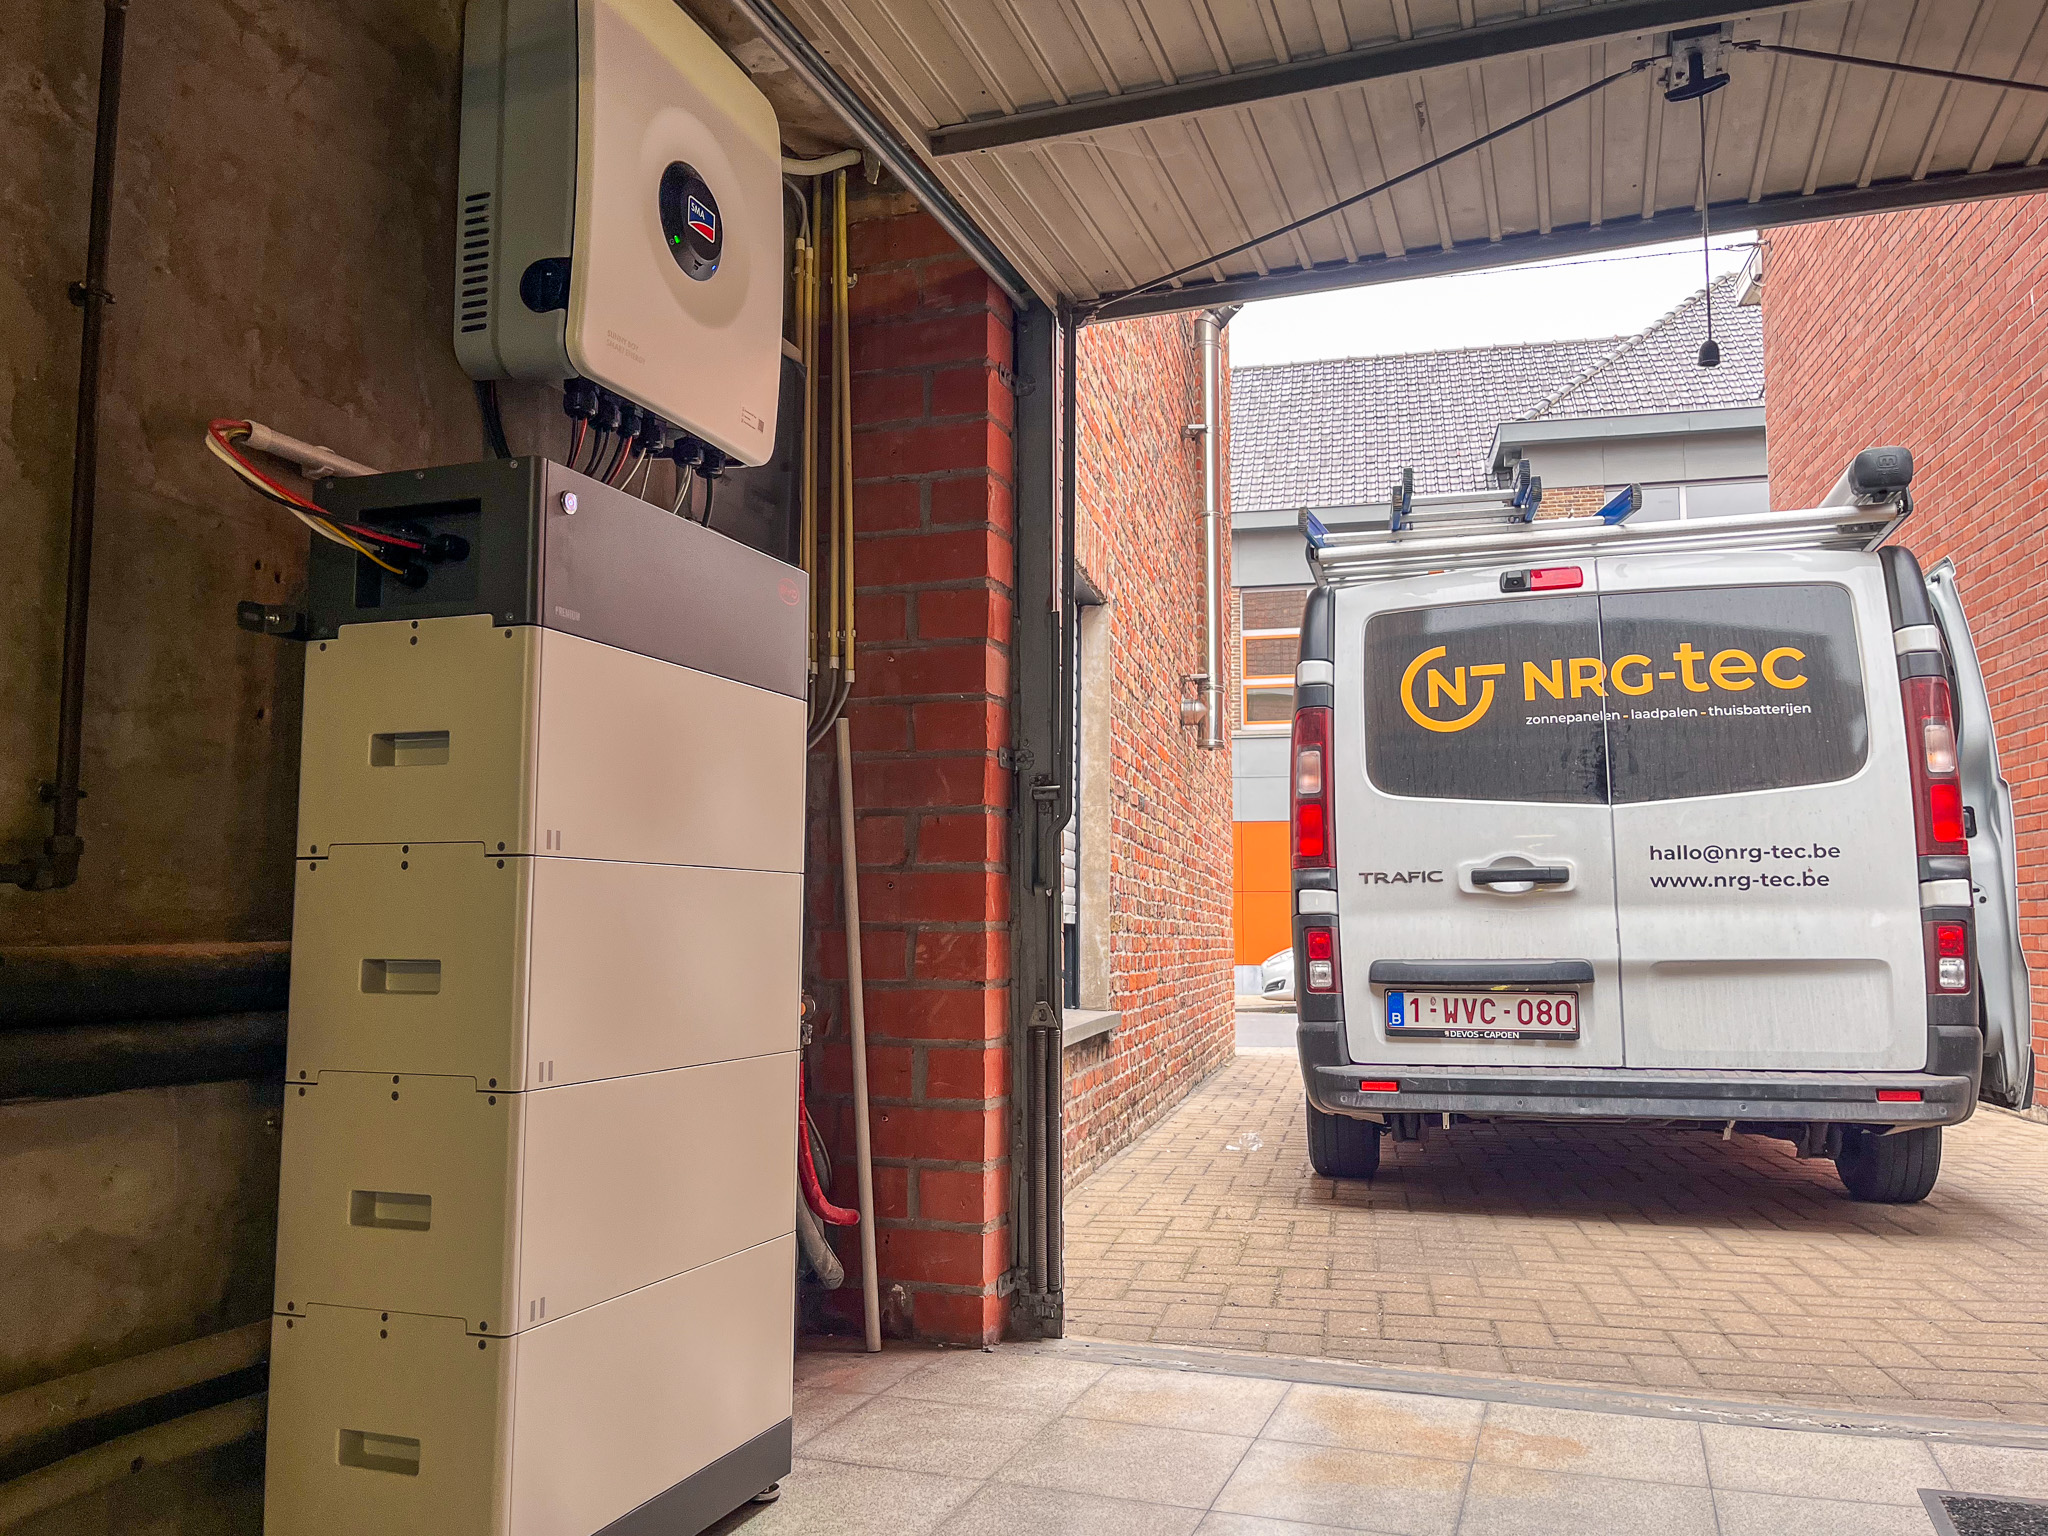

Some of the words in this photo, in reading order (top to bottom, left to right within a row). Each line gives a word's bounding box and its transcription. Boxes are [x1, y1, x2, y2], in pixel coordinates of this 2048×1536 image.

[690, 202, 706, 221] SMA
[555, 605, 581, 621] PREMIUM
[1522, 642, 1809, 702] NRG-tec
[1525, 709, 1620, 725] zonnepanelen
[1630, 706, 1698, 720] laadpalen
[1708, 702, 1812, 717] thuisbatterijen
[1649, 843, 1841, 864] hallo@nrg-tec.be
[1358, 870, 1444, 885] TRAFIC
[1649, 871, 1830, 891] www.nrg-tec.be
[1391, 1012, 1402, 1025] B
